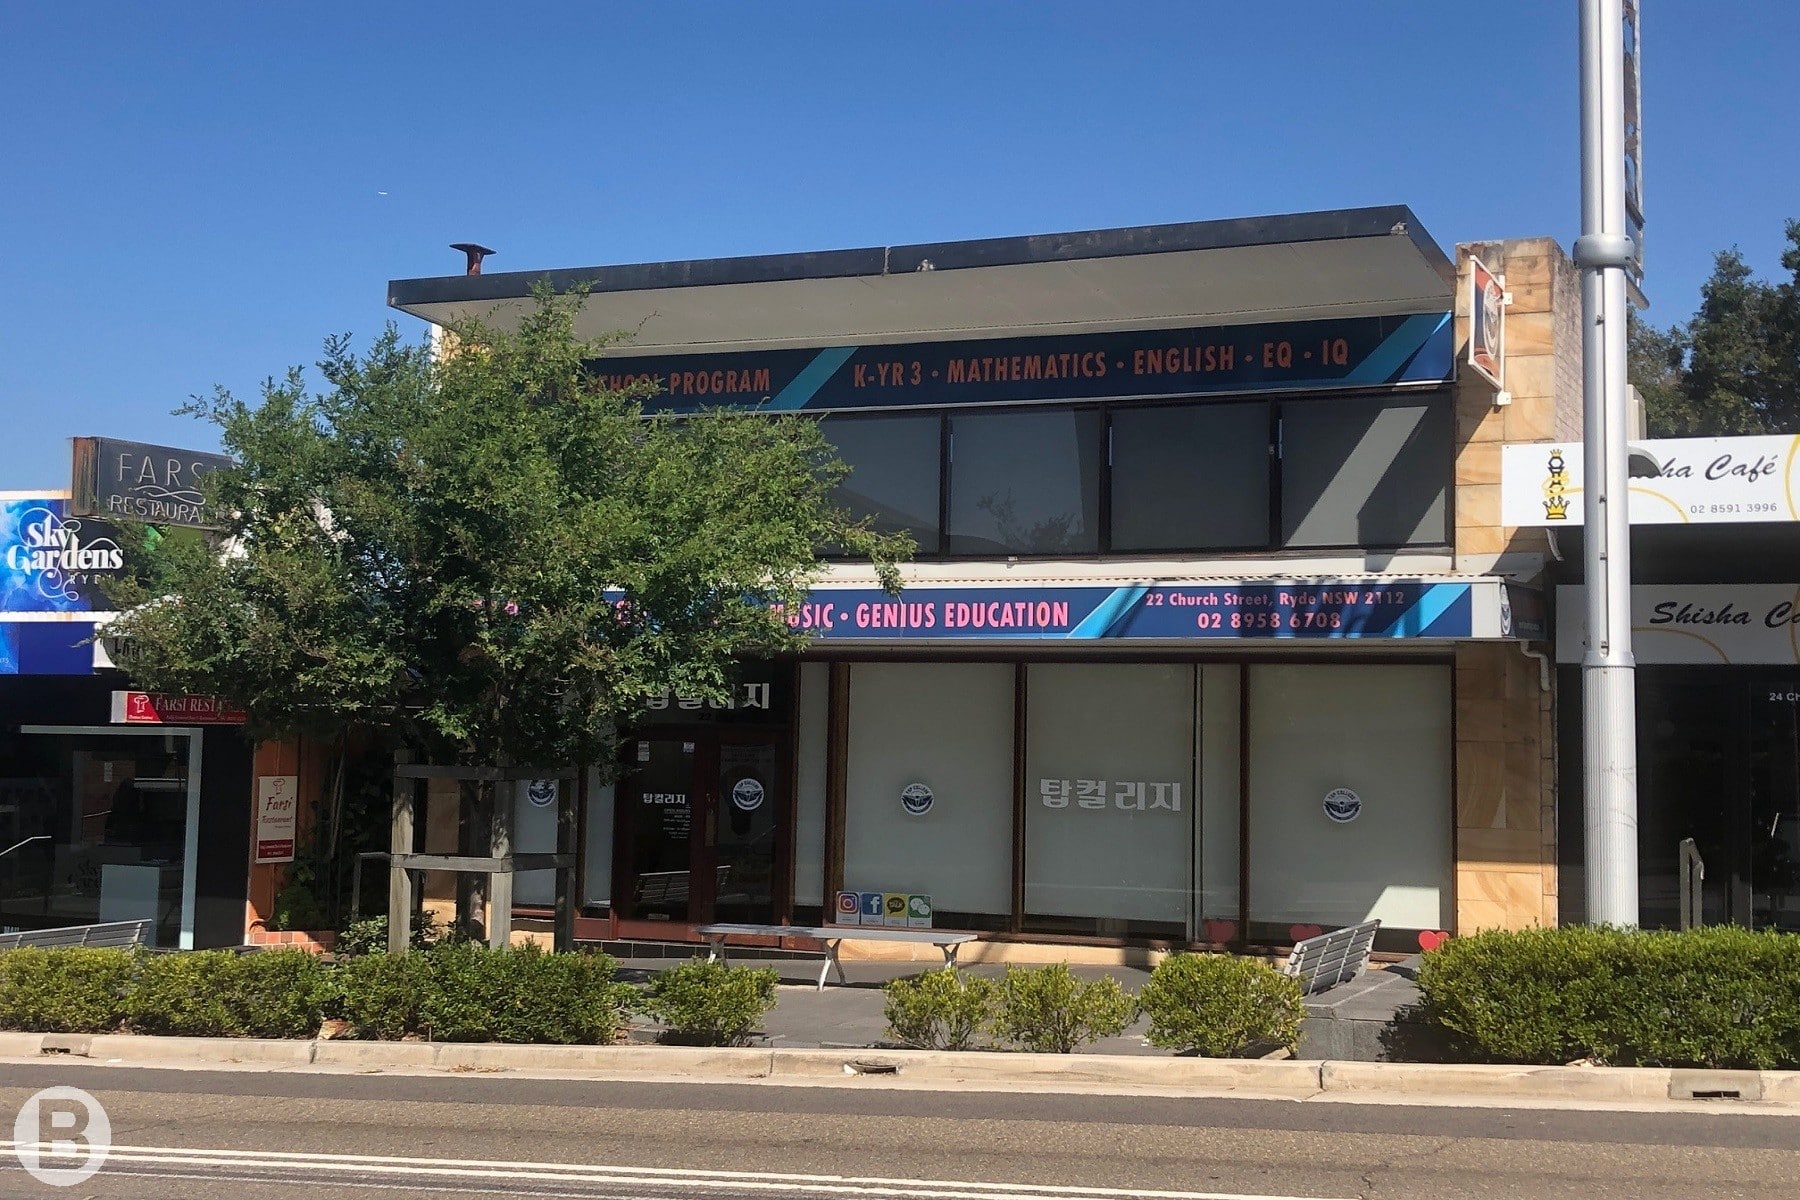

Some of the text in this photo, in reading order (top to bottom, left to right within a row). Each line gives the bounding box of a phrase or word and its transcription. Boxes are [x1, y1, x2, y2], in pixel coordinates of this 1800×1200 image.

[669, 368, 771, 394] PROGRAM
[853, 361, 904, 387] K-YR
[910, 361, 921, 386] 3
[946, 351, 1107, 384] MATHEMATICS
[1133, 344, 1235, 375] ENGLISH
[1262, 340, 1293, 369] EQ
[1322, 338, 1349, 366] IQ
[117, 453, 208, 490] FARS
[1704, 453, 1779, 482] Café
[109, 494, 204, 524] RESTAURA
[1690, 502, 1778, 514] 02 8591 3996
[26, 511, 74, 548] Sky
[7, 533, 124, 575] Gardens
[1145, 591, 1405, 610] 22 Church Street, Ryde NSW 2112
[1650, 601, 1752, 626] Shisha
[855, 601, 937, 629] GENIUS
[944, 601, 1070, 628] EDUCATION
[1197, 611, 1342, 630] 02 8958 6708
[156, 697, 187, 712] FARSI
[1769, 692, 1783, 701] 24
[266, 796, 293, 811] Farsi
[1040, 778, 1181, 811] 탑컬리지
